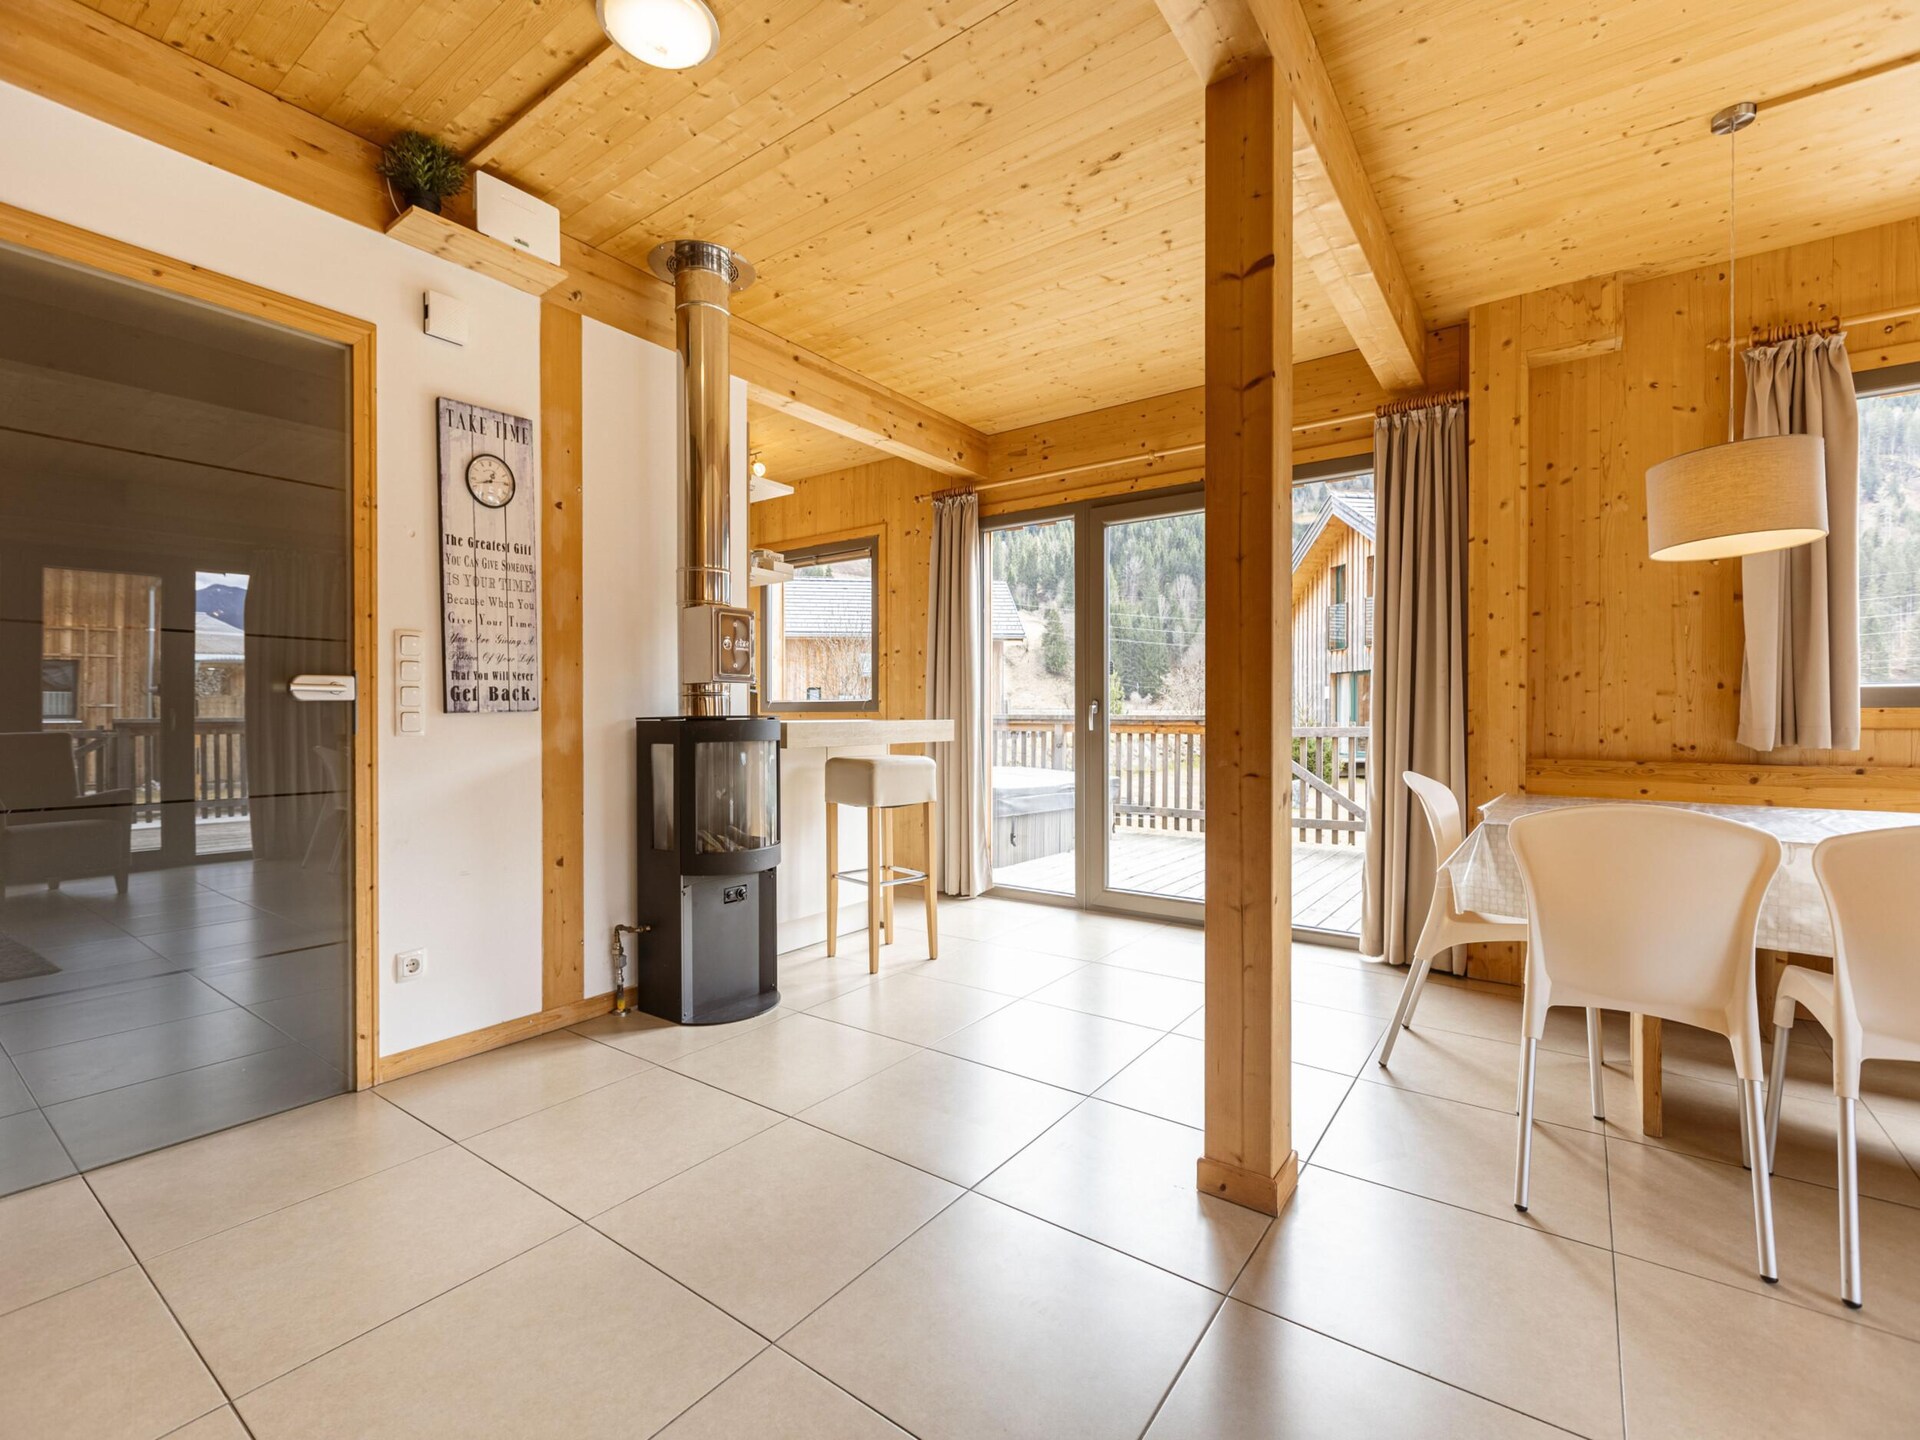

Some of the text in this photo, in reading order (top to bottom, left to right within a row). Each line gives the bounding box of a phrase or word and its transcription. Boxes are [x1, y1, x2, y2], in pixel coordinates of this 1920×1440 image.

[446, 408, 529, 446] TAKE TIME
[445, 534, 532, 556] The Greatest Gift
[446, 572, 460, 586] IS
[463, 574, 496, 589] YOUR
[446, 593, 535, 610] Because When You
[448, 611, 536, 629] Give Your Time.
[494, 634, 521, 647] Giving
[451, 670, 534, 681] That You Will Never
[450, 686, 536, 702] Get Back.
